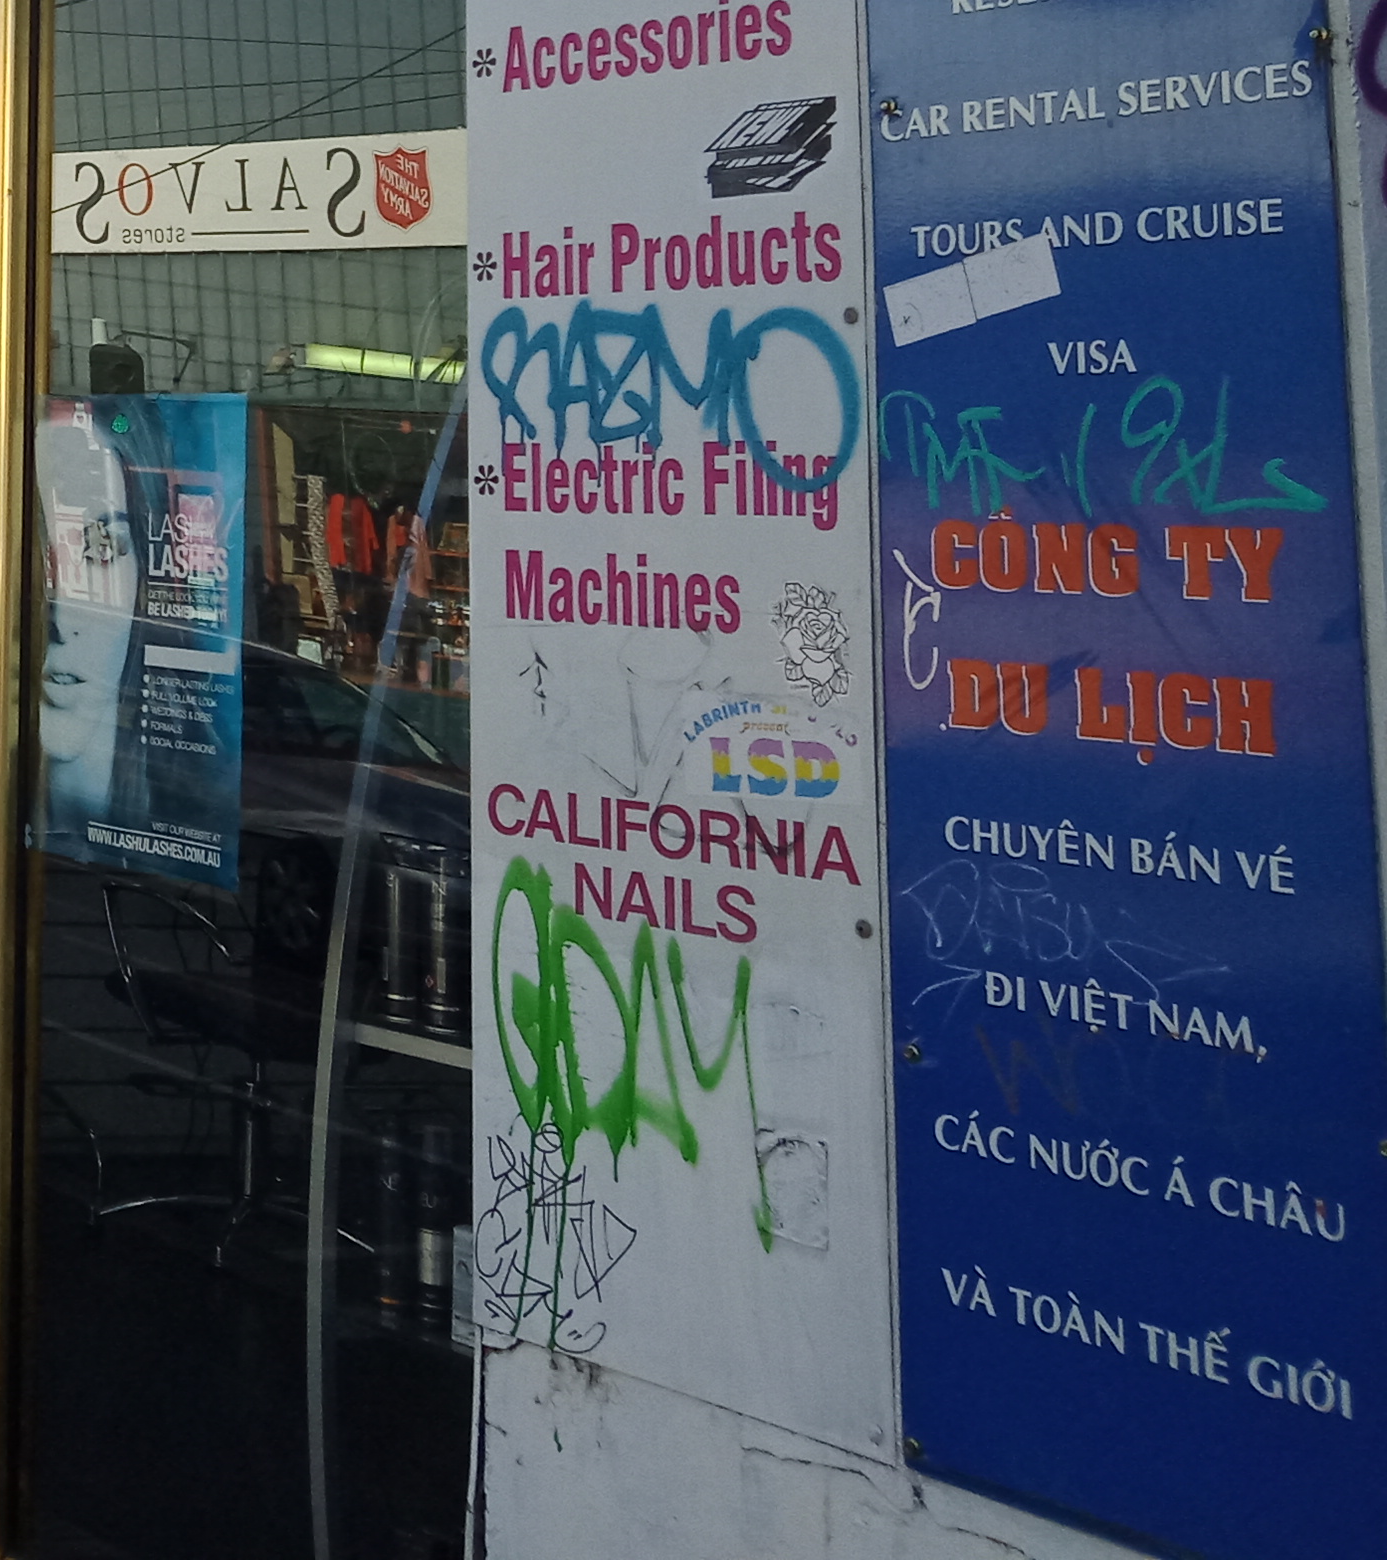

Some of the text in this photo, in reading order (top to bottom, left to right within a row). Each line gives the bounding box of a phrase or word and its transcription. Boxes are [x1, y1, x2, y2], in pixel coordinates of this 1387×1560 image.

[879, 60, 1314, 142] CAR RENTAL SERVICES
[502, 211, 842, 299] Hair Products
[910, 198, 1285, 258] TOURS AND CRUISE
[1047, 338, 1138, 375] VISA
[502, 441, 684, 516] Electric
[504, 549, 741, 635] Machines
[931, 505, 1284, 603] CÔNG TY
[947, 658, 1277, 766] DU LỊCH
[709, 736, 841, 799] LSD
[87, 826, 221, 869] WWW.LASHULASHES.COM.AU
[488, 782, 862, 887] CALIFORNIA
[945, 816, 1295, 895] CHUYÊN BÁN VÉ
[573, 861, 759, 944] NAILS
[985, 970, 1268, 1064] ĐI VIỆT NAM,
[933, 1109, 1346, 1242] CÁC NƯỚC Á CHÂU
[941, 1264, 1353, 1421] VÀ TOÀN THẾ GIỚI
